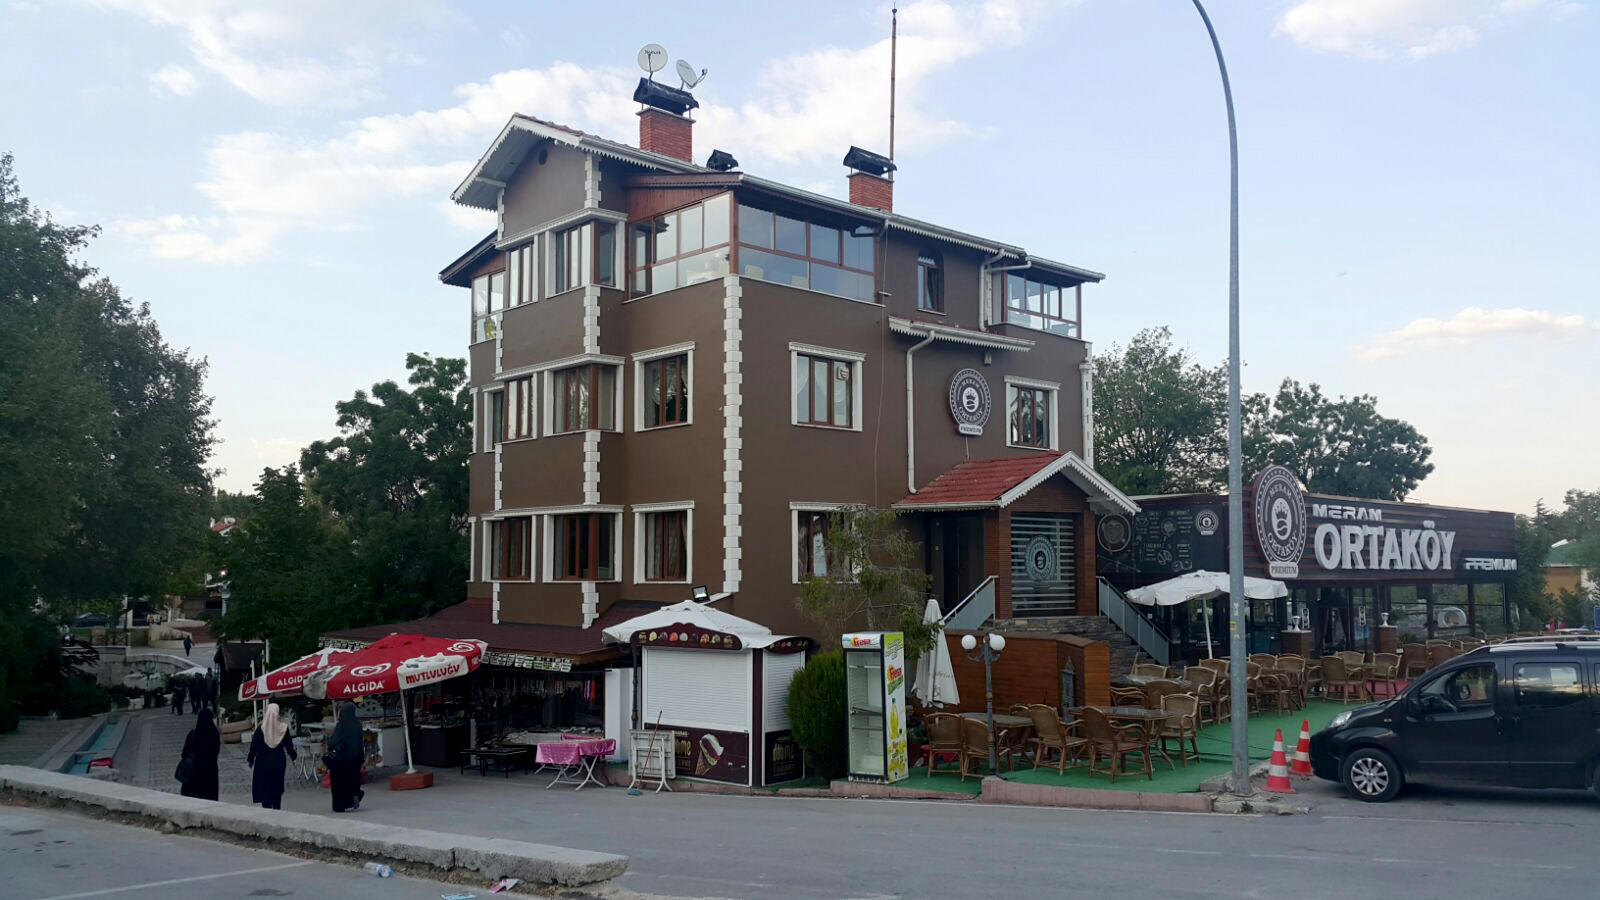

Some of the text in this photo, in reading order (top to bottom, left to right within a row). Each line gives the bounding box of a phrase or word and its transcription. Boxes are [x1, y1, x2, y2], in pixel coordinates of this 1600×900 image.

[1269, 483, 1292, 499] MERAM
[1312, 503, 1382, 521] MERAM
[1267, 530, 1298, 557] ORTAKÖY
[1314, 520, 1456, 570] ORTAKÖY
[1271, 565, 1297, 574] PREMIUM
[1464, 557, 1518, 571] PREMIUM
[276, 675, 303, 687] ALGiD
